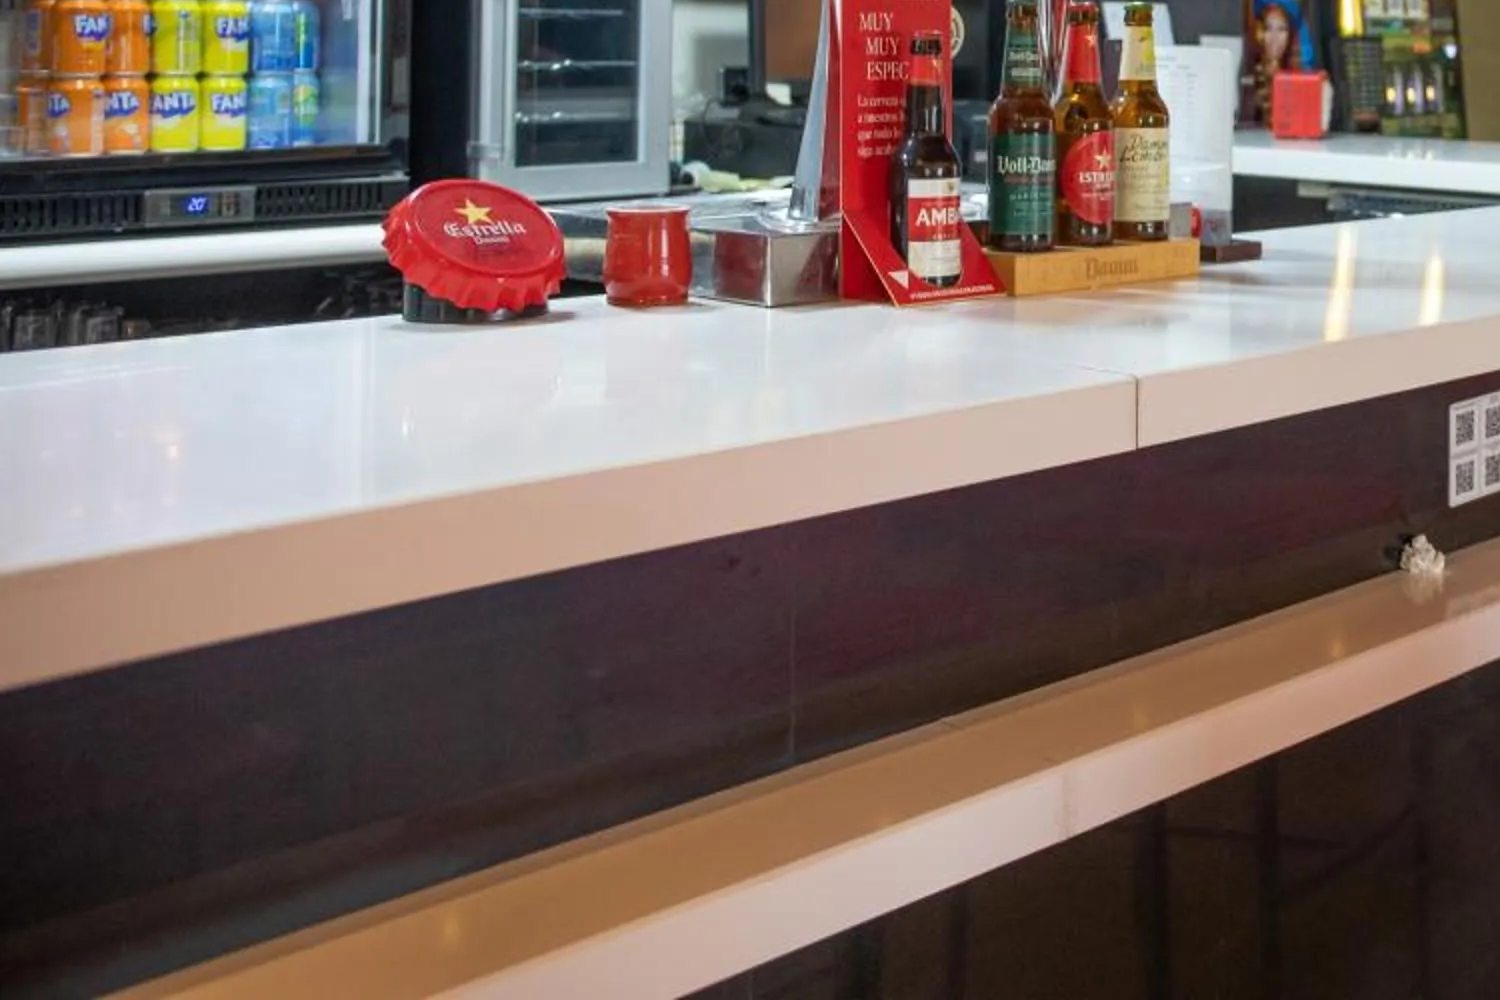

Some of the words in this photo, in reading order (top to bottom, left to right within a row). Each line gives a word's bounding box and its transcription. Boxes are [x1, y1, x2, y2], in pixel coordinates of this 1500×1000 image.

[75, 14, 111, 36] FAN
[216, 16, 248, 37] FAN
[859, 12, 894, 32] MUY
[866, 36, 899, 56] MUY
[867, 61, 910, 81] ESPEC
[212, 93, 247, 113] FAN
[1079, 171, 1115, 184] ESTRE
[914, 207, 957, 227] AMB
[443, 219, 528, 239] Estrella
